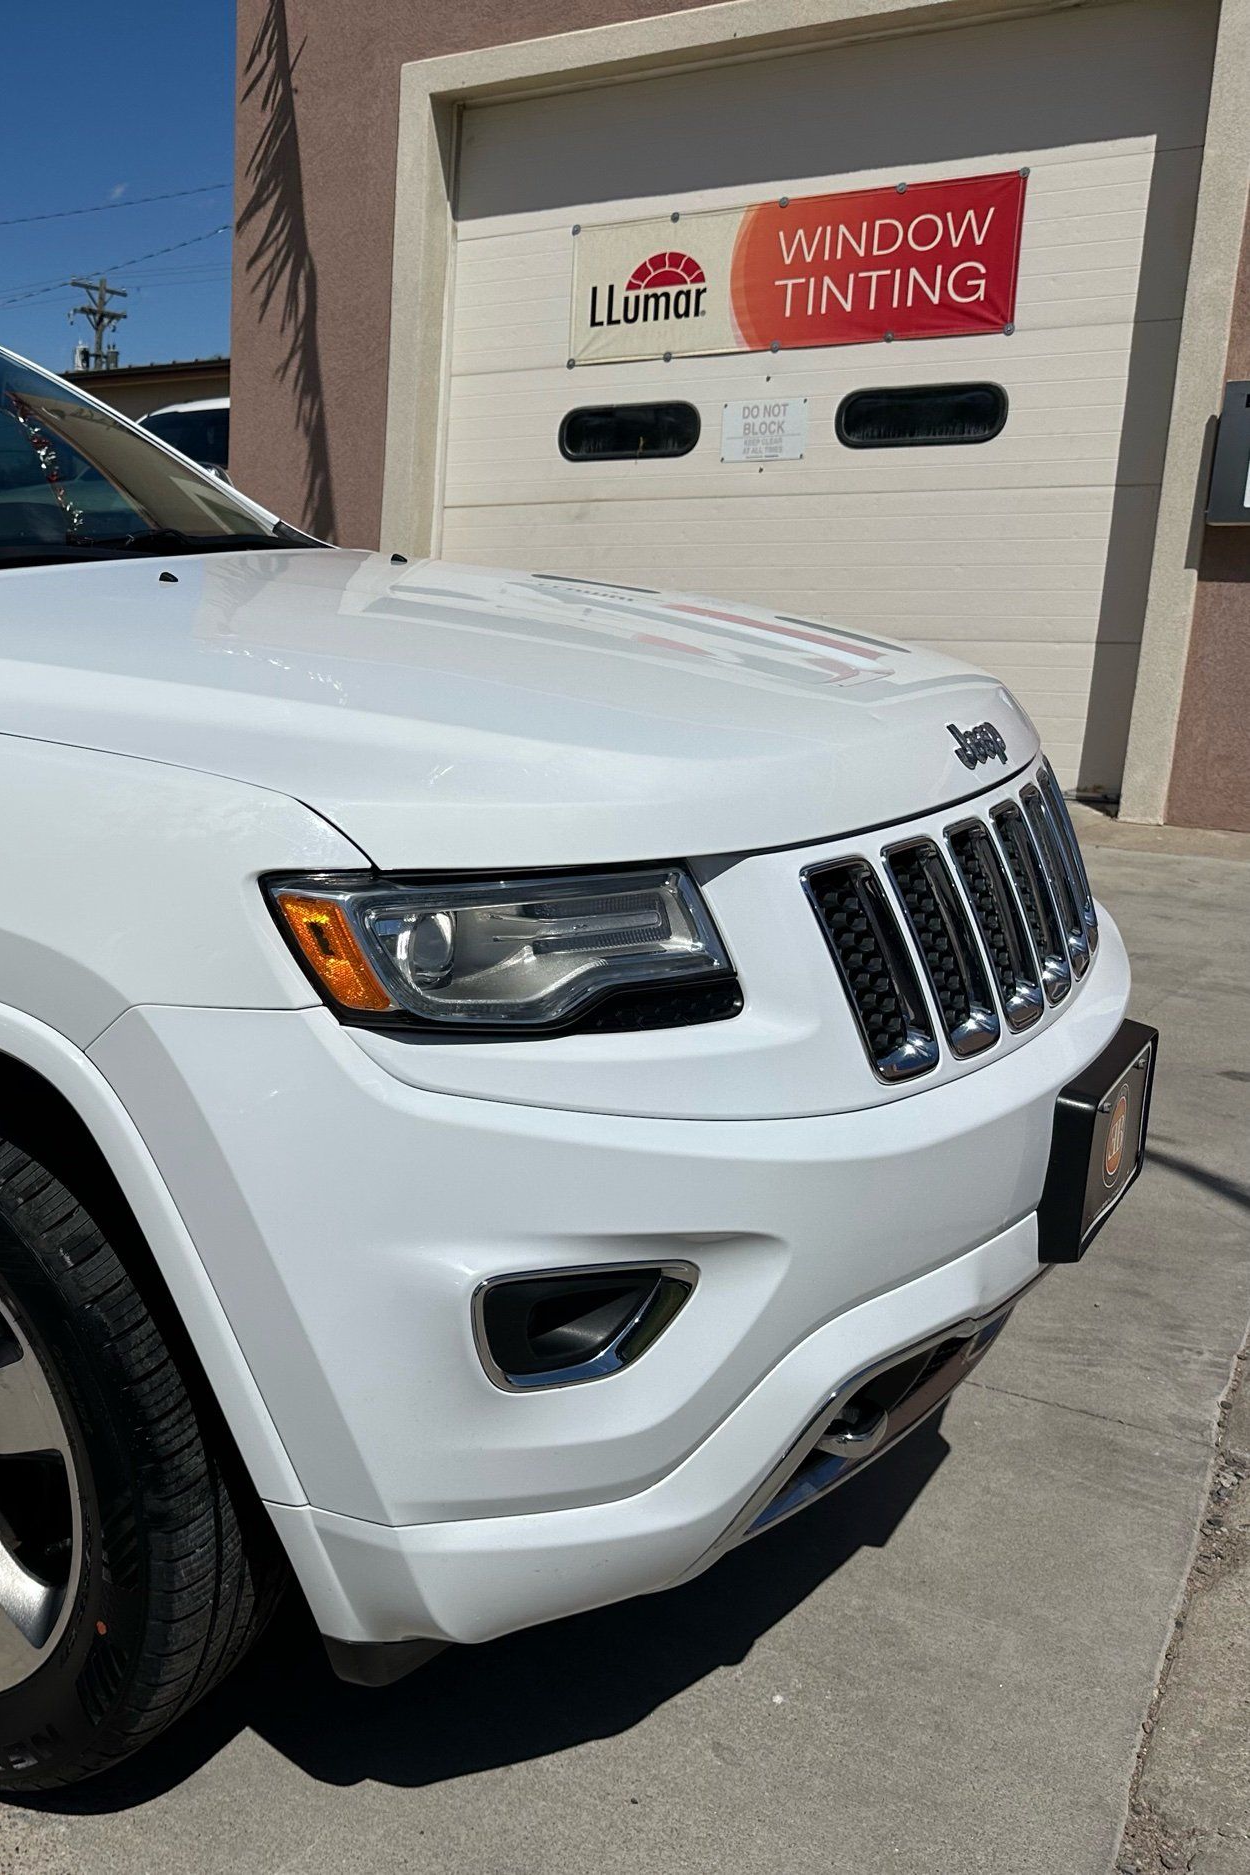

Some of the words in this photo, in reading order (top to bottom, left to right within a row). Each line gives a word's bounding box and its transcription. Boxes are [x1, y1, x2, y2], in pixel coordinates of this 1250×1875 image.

[778, 206, 995, 265] WINDOW
[590, 284, 707, 328] LLumar
[774, 261, 987, 318] TINTING
[742, 405, 760, 419] DO
[763, 403, 789, 418] NOT
[743, 420, 785, 436] BLOCK
[946, 721, 1009, 770] Jeep
